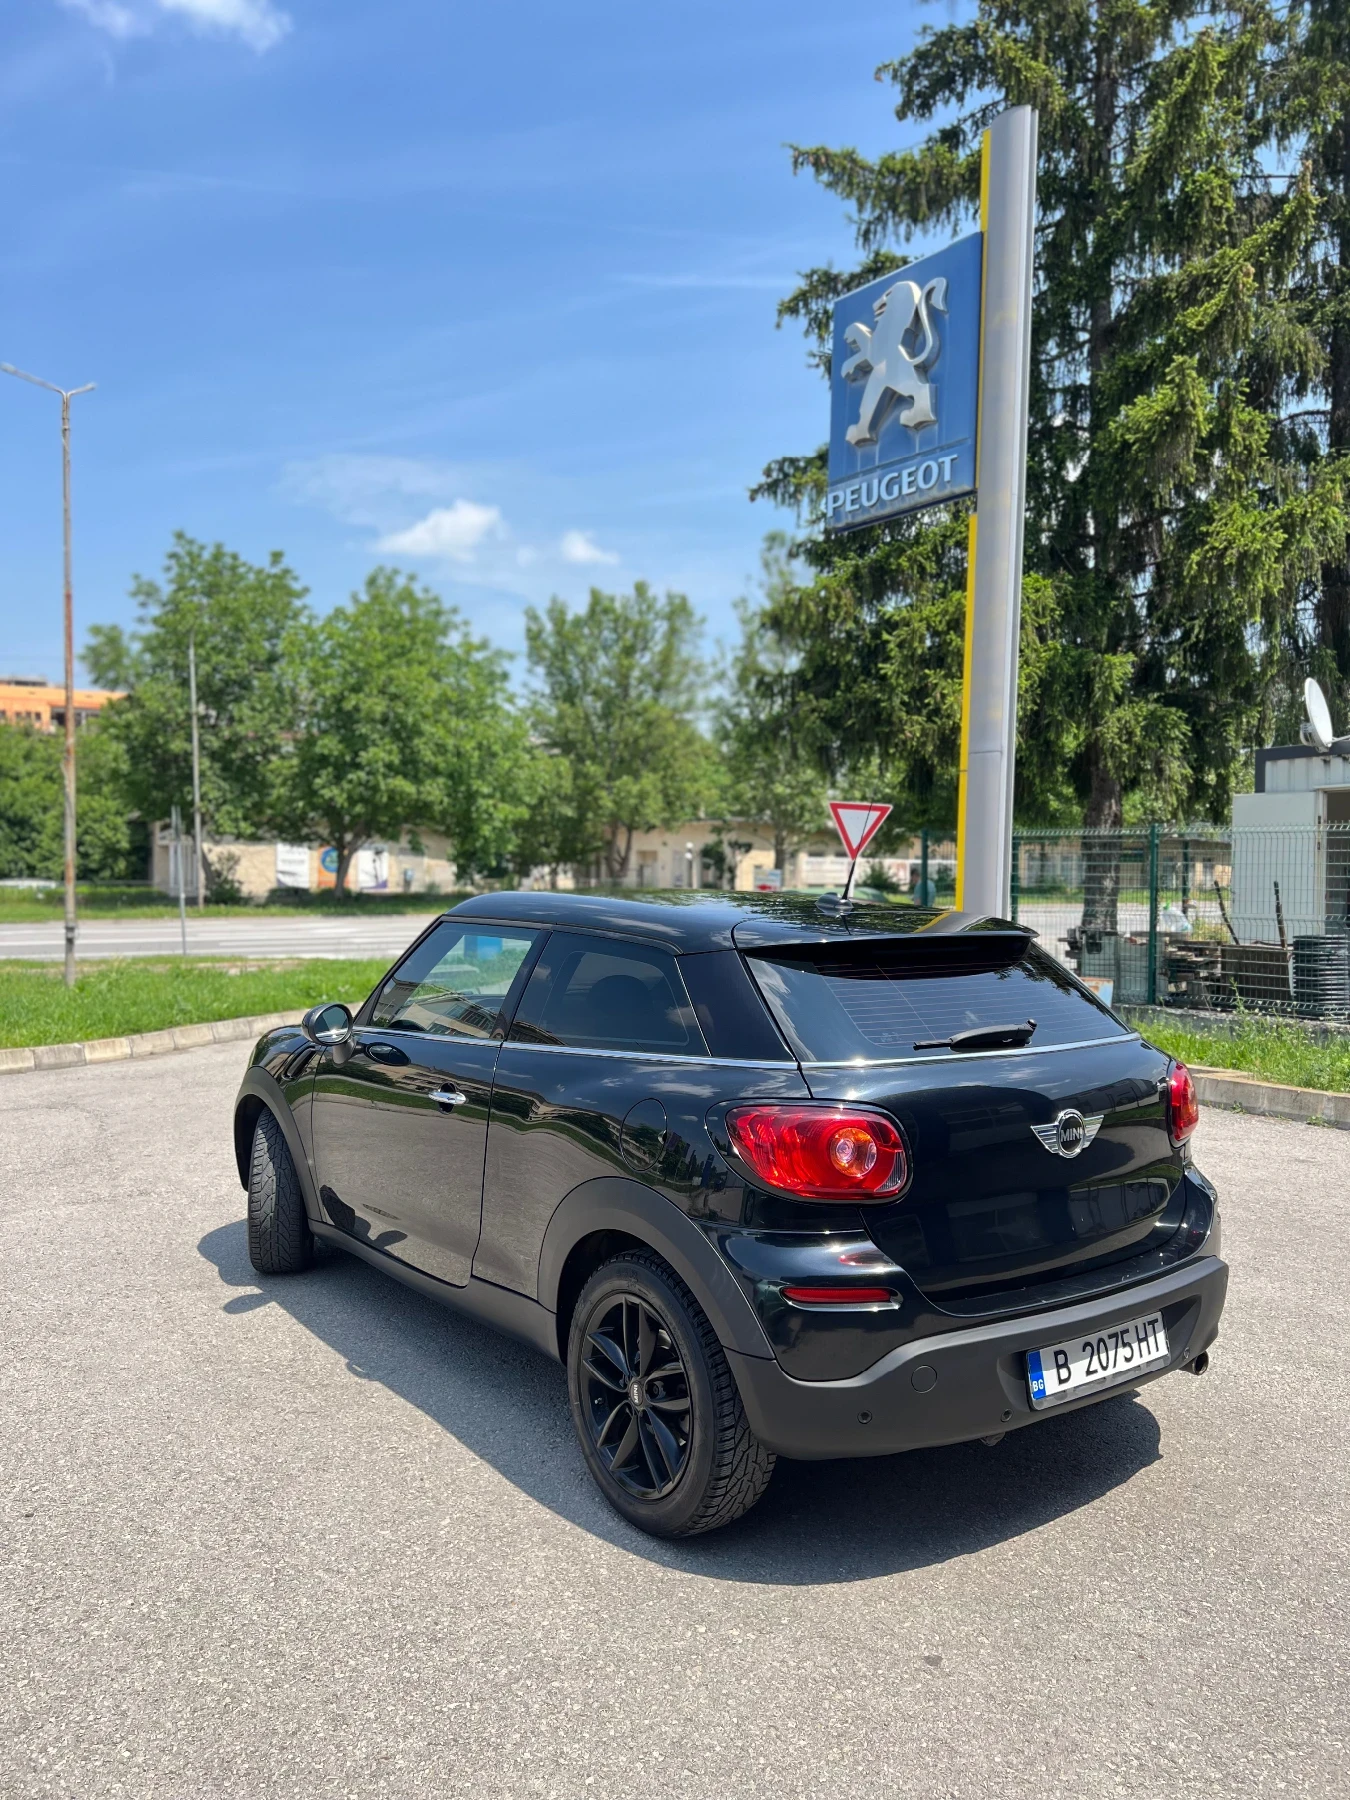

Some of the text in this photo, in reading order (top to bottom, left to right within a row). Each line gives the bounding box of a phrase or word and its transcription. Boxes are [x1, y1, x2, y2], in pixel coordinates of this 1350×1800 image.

[827, 454, 958, 518] PEUGEOT
[1060, 1127, 1083, 1142] MINI
[1053, 1318, 1160, 1386] B 2075 HT
[1032, 1379, 1045, 1392] BG
